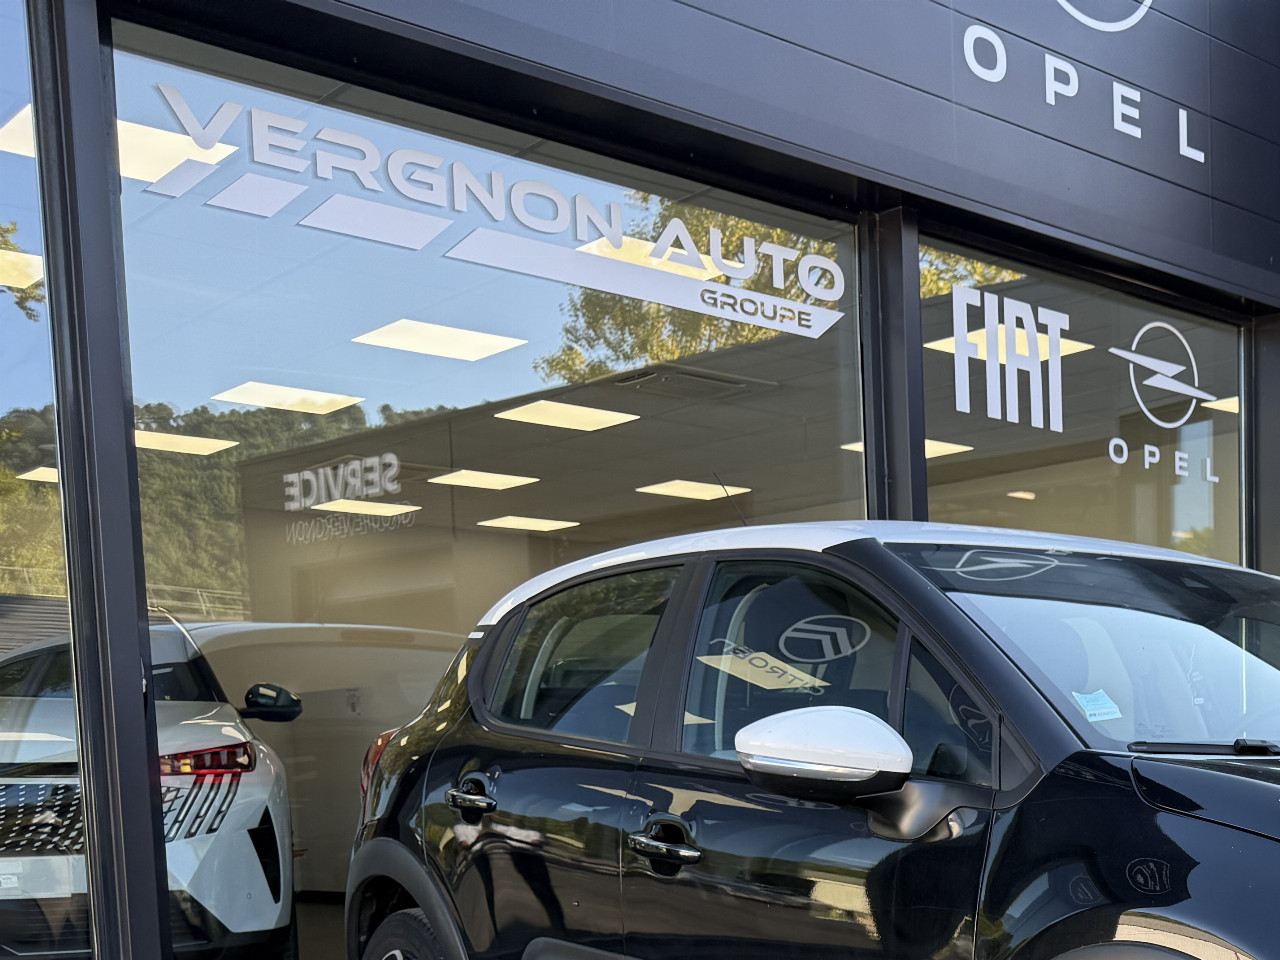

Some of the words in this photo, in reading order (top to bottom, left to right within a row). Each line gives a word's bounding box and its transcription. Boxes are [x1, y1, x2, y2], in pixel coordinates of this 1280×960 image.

[963, 24, 1206, 163] OPEL
[156, 83, 624, 250] VERGNON
[649, 217, 845, 302] AUTO
[699, 288, 813, 330] GROUPE
[952, 284, 1070, 433] FIAT
[1108, 436, 1220, 483] OPEL
